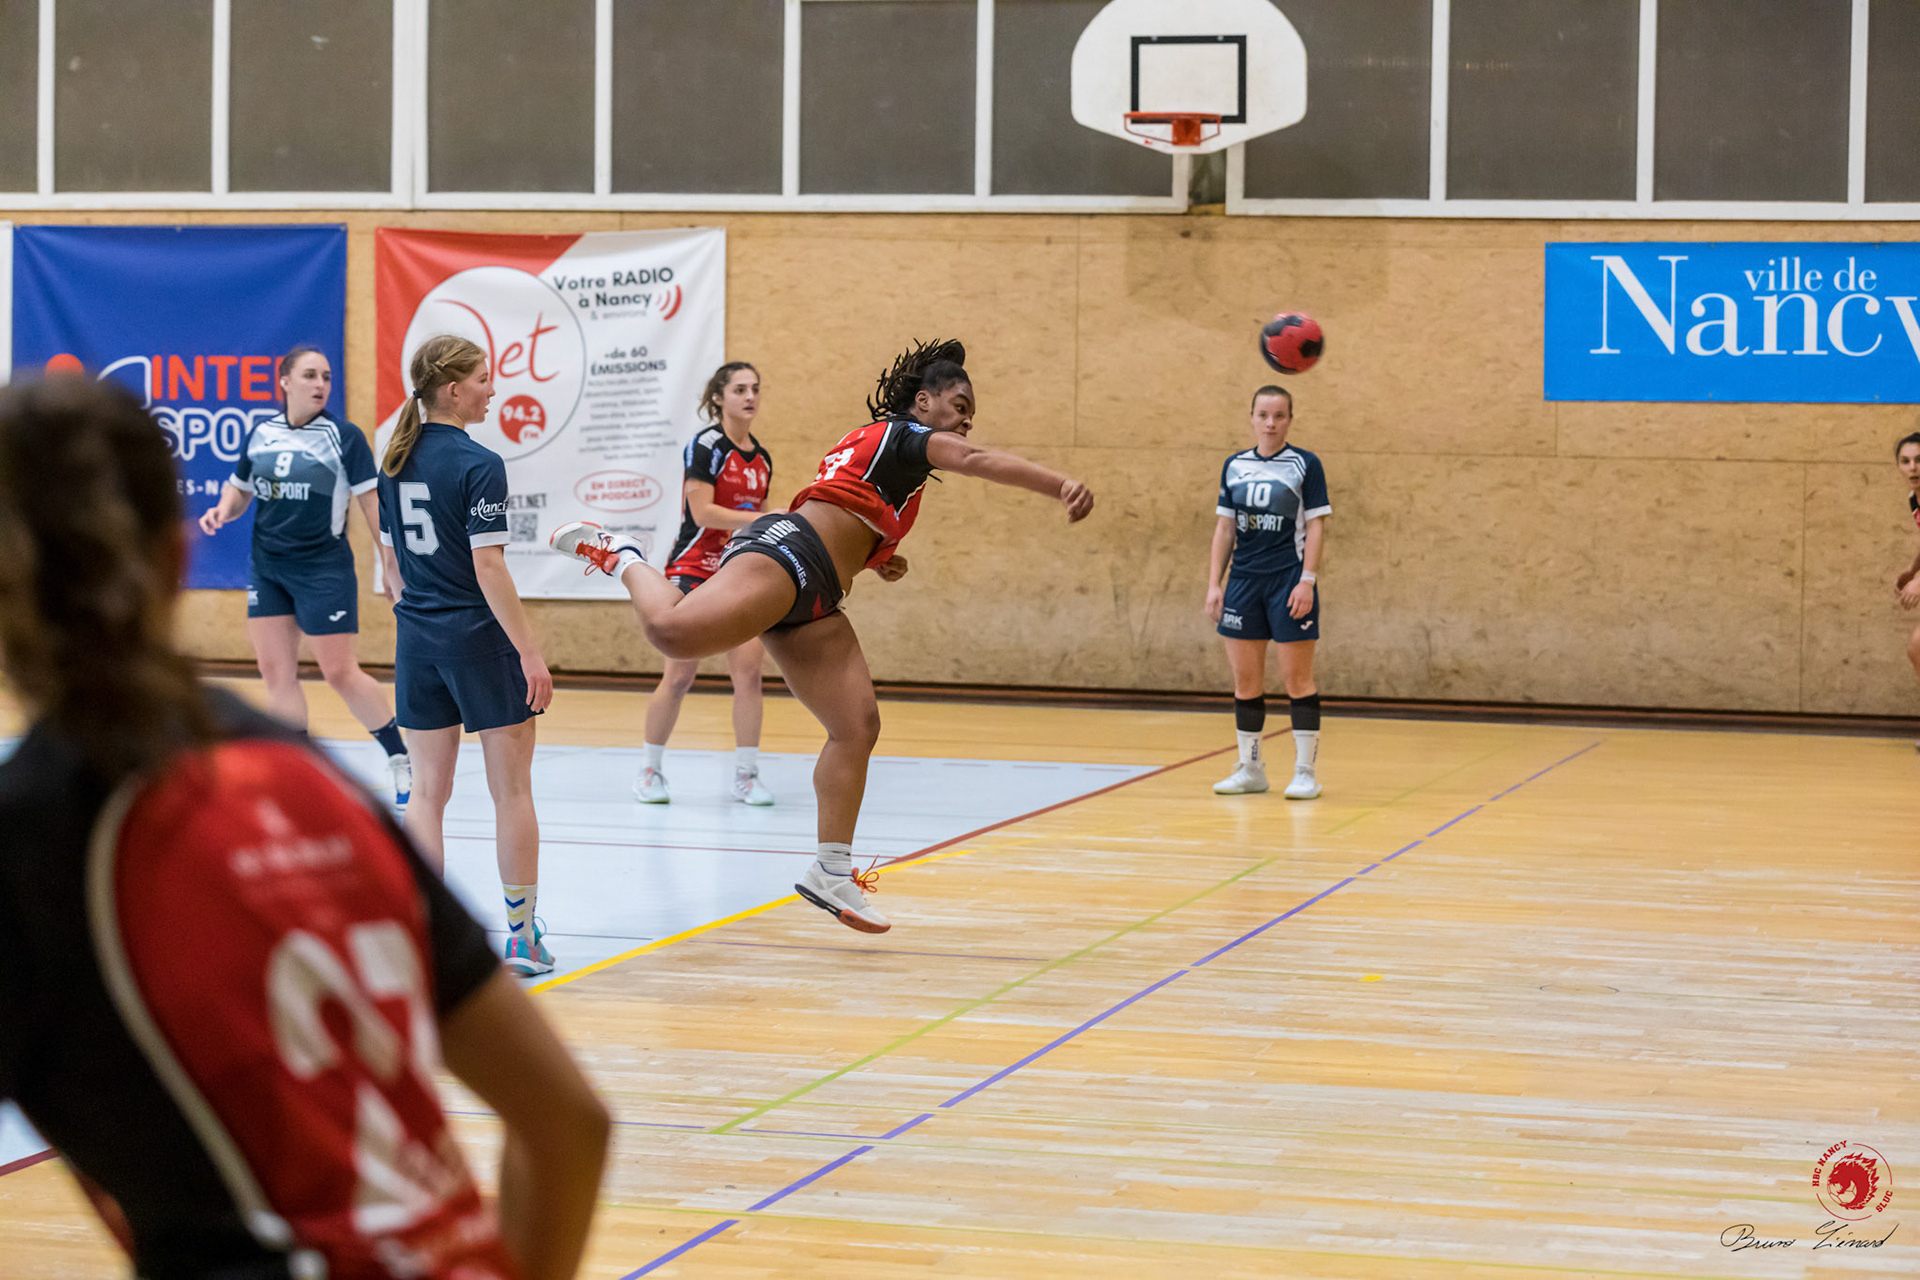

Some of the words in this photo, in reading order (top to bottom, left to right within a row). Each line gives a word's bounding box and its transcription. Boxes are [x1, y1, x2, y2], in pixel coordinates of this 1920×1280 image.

[553, 275, 607, 291] Votre
[612, 266, 674, 287] RADIO
[1744, 256, 1823, 292] ville
[1833, 256, 1877, 292] de
[578, 292, 590, 309] à
[595, 292, 652, 308] Nancy
[631, 345, 649, 358] 60
[502, 405, 542, 422] 94.2
[273, 451, 295, 478] 9
[272, 482, 312, 501] SPORT
[601, 489, 652, 500] PODCAST
[1245, 482, 1273, 508] 10
[399, 482, 440, 556] 5
[1250, 513, 1285, 532] SPORT
